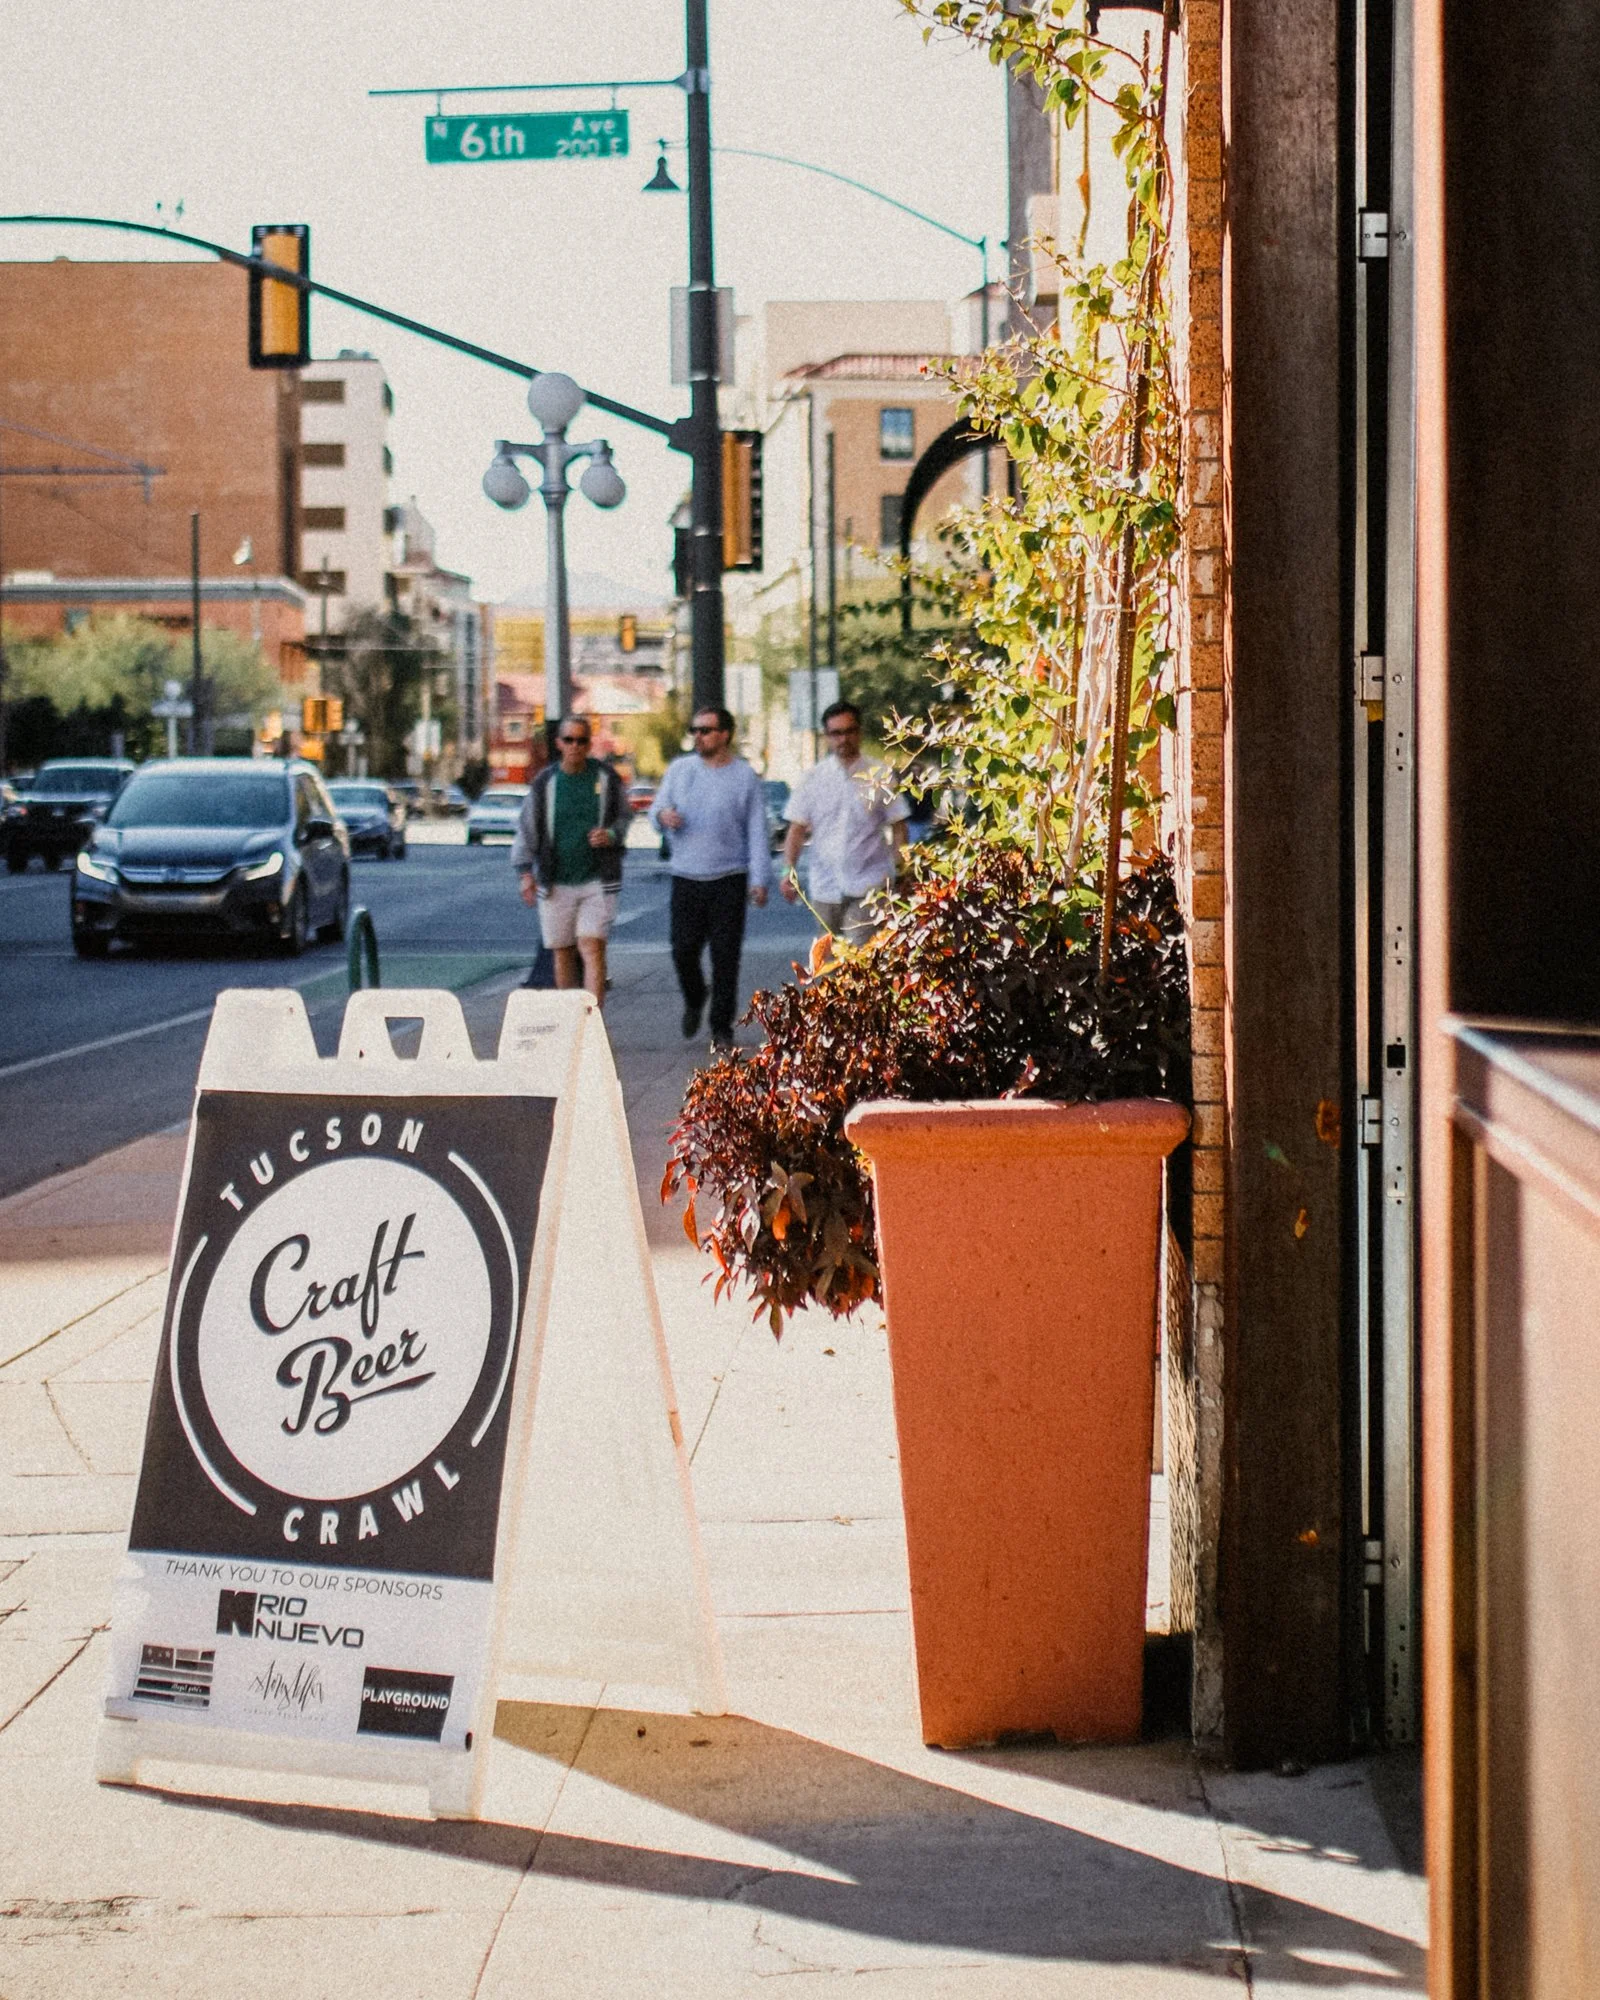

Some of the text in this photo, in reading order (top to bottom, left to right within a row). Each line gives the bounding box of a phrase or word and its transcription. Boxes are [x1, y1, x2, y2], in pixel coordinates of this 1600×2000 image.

[432, 116, 616, 159] N 6th Ave
[555, 137, 622, 158] 200 E
[219, 1112, 424, 1211] TUCSON
[250, 1212, 425, 1340] Craft
[275, 1328, 436, 1437] Beer
[283, 1460, 460, 1545] CRAWL
[165, 1559, 444, 1601] THANK YOU TO OUR SPONSORS
[257, 1593, 308, 1618] RIO
[254, 1618, 365, 1649] NUEVO
[362, 1687, 450, 1711] PLAYGROUND
